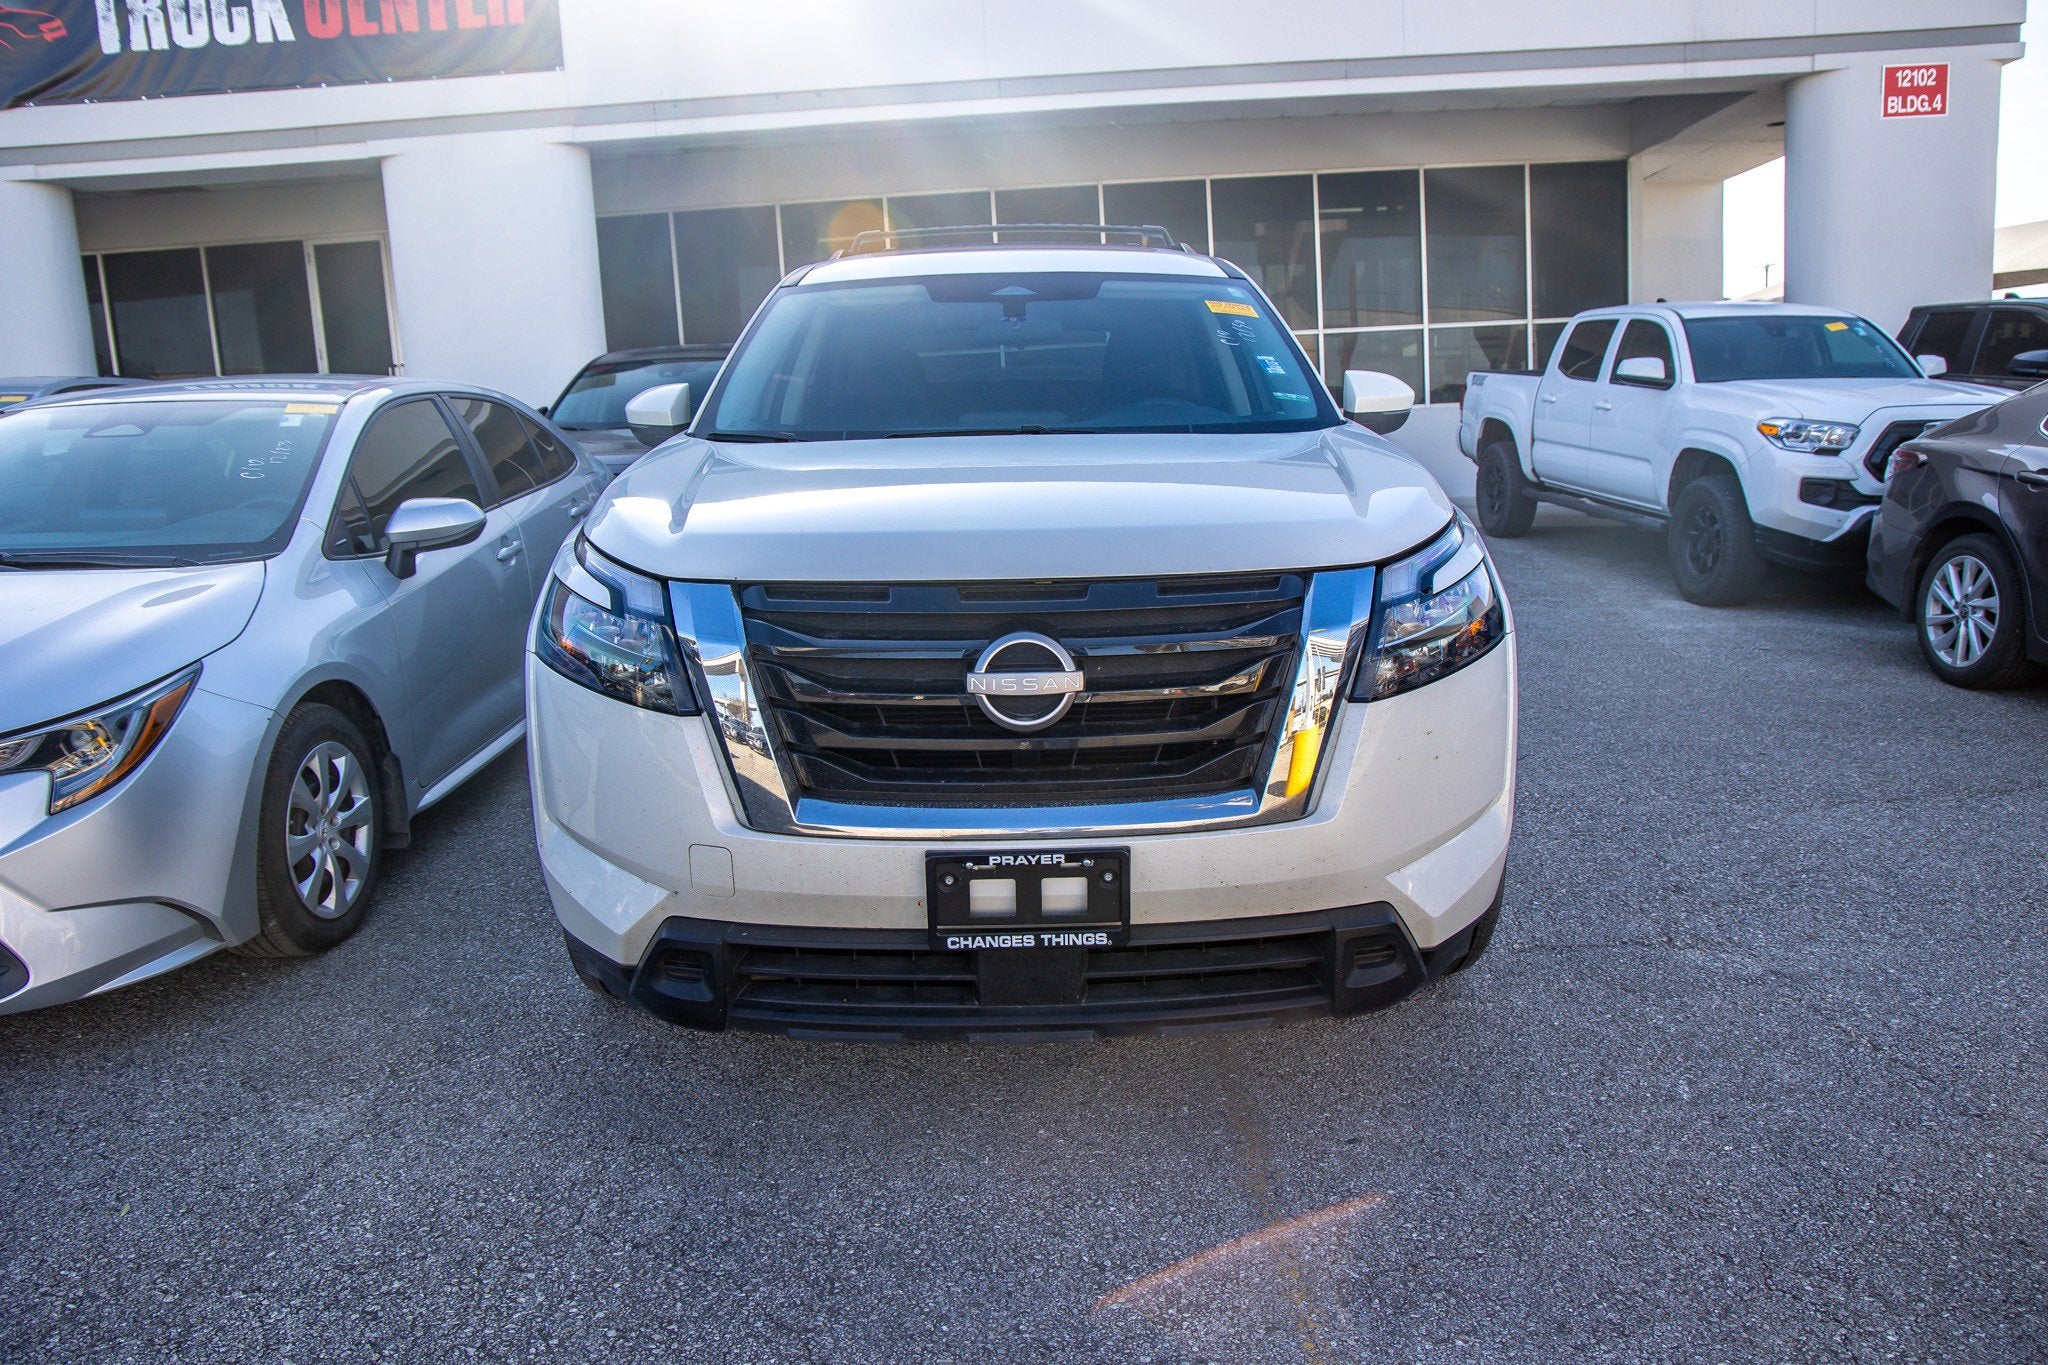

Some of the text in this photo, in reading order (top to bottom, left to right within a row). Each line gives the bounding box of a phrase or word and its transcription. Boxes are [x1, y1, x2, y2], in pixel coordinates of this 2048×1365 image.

[1895, 68, 1938, 88] 12102
[969, 673, 1081, 692] NISSAN
[988, 853, 1066, 867] PRAYER
[946, 933, 1036, 950] CHANGES
